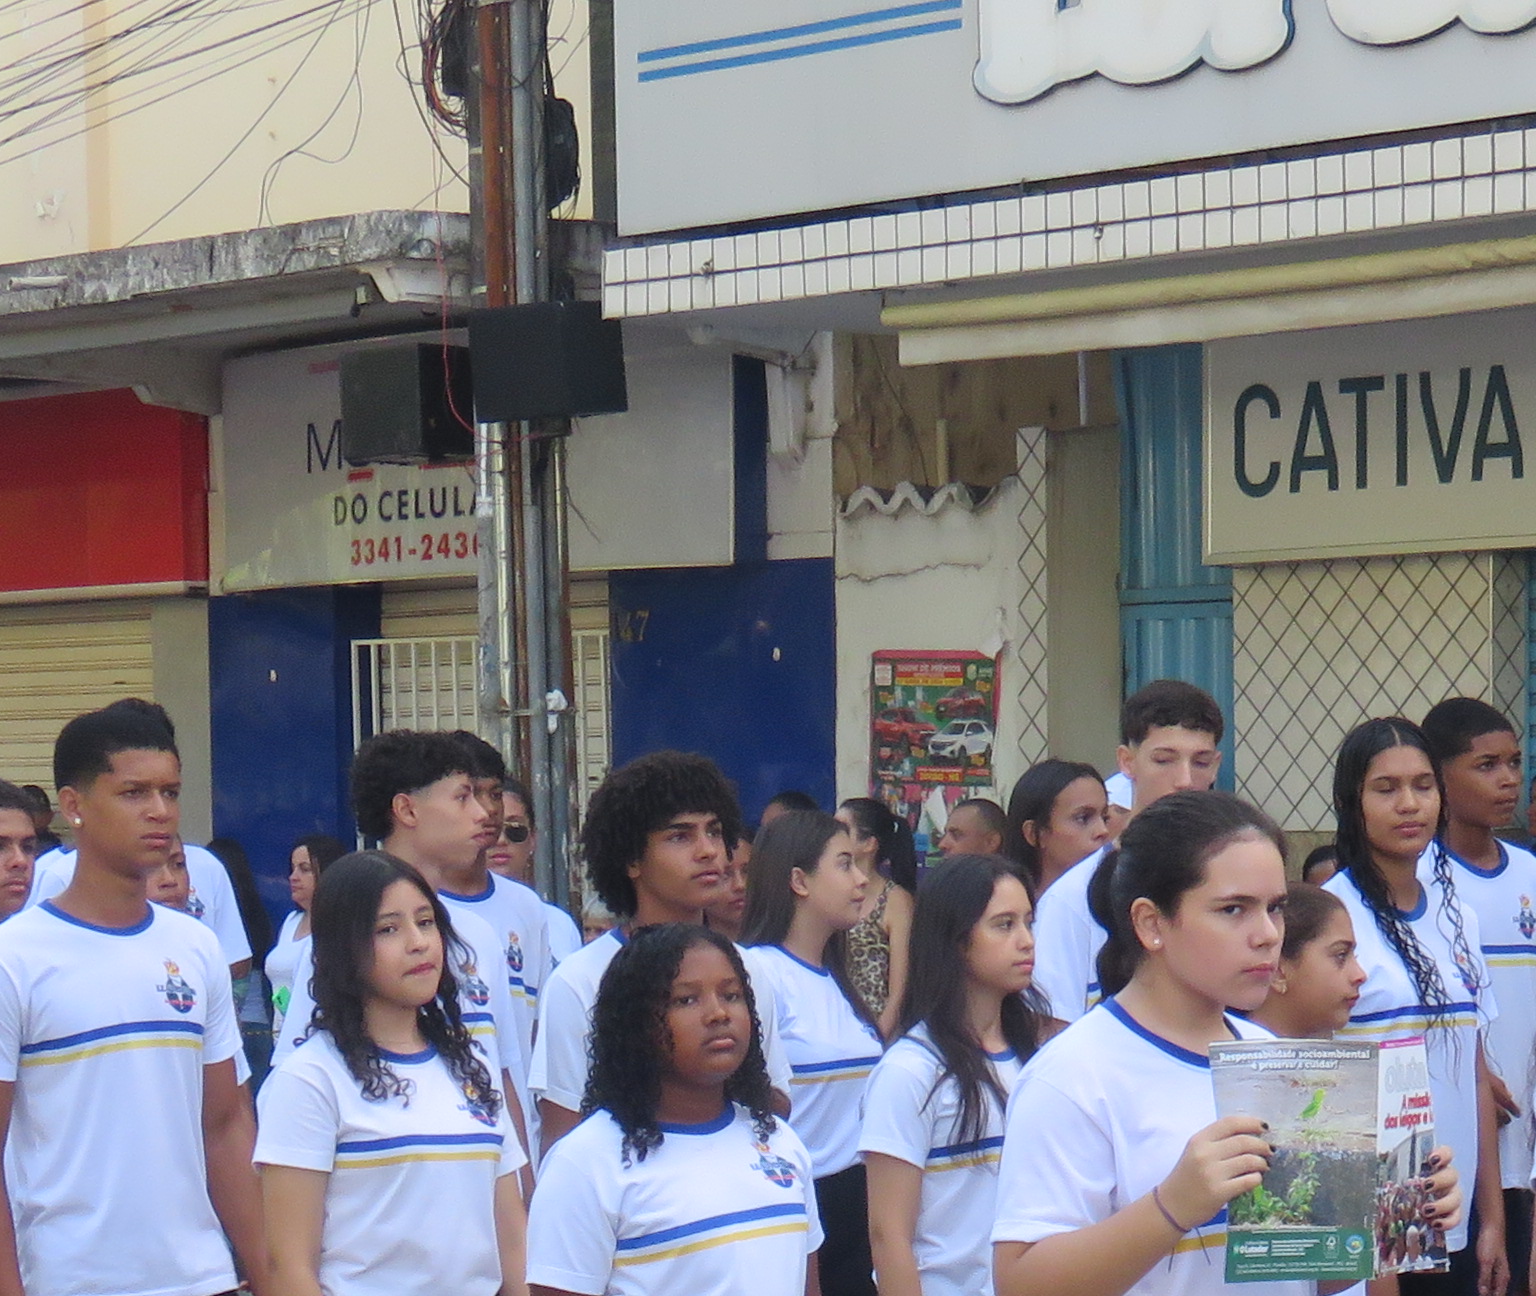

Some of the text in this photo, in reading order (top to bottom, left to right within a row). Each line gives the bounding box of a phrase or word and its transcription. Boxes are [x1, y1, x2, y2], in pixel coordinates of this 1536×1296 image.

[1233, 364, 1524, 498] CATIVA
[333, 486, 477, 526] DO CELUL
